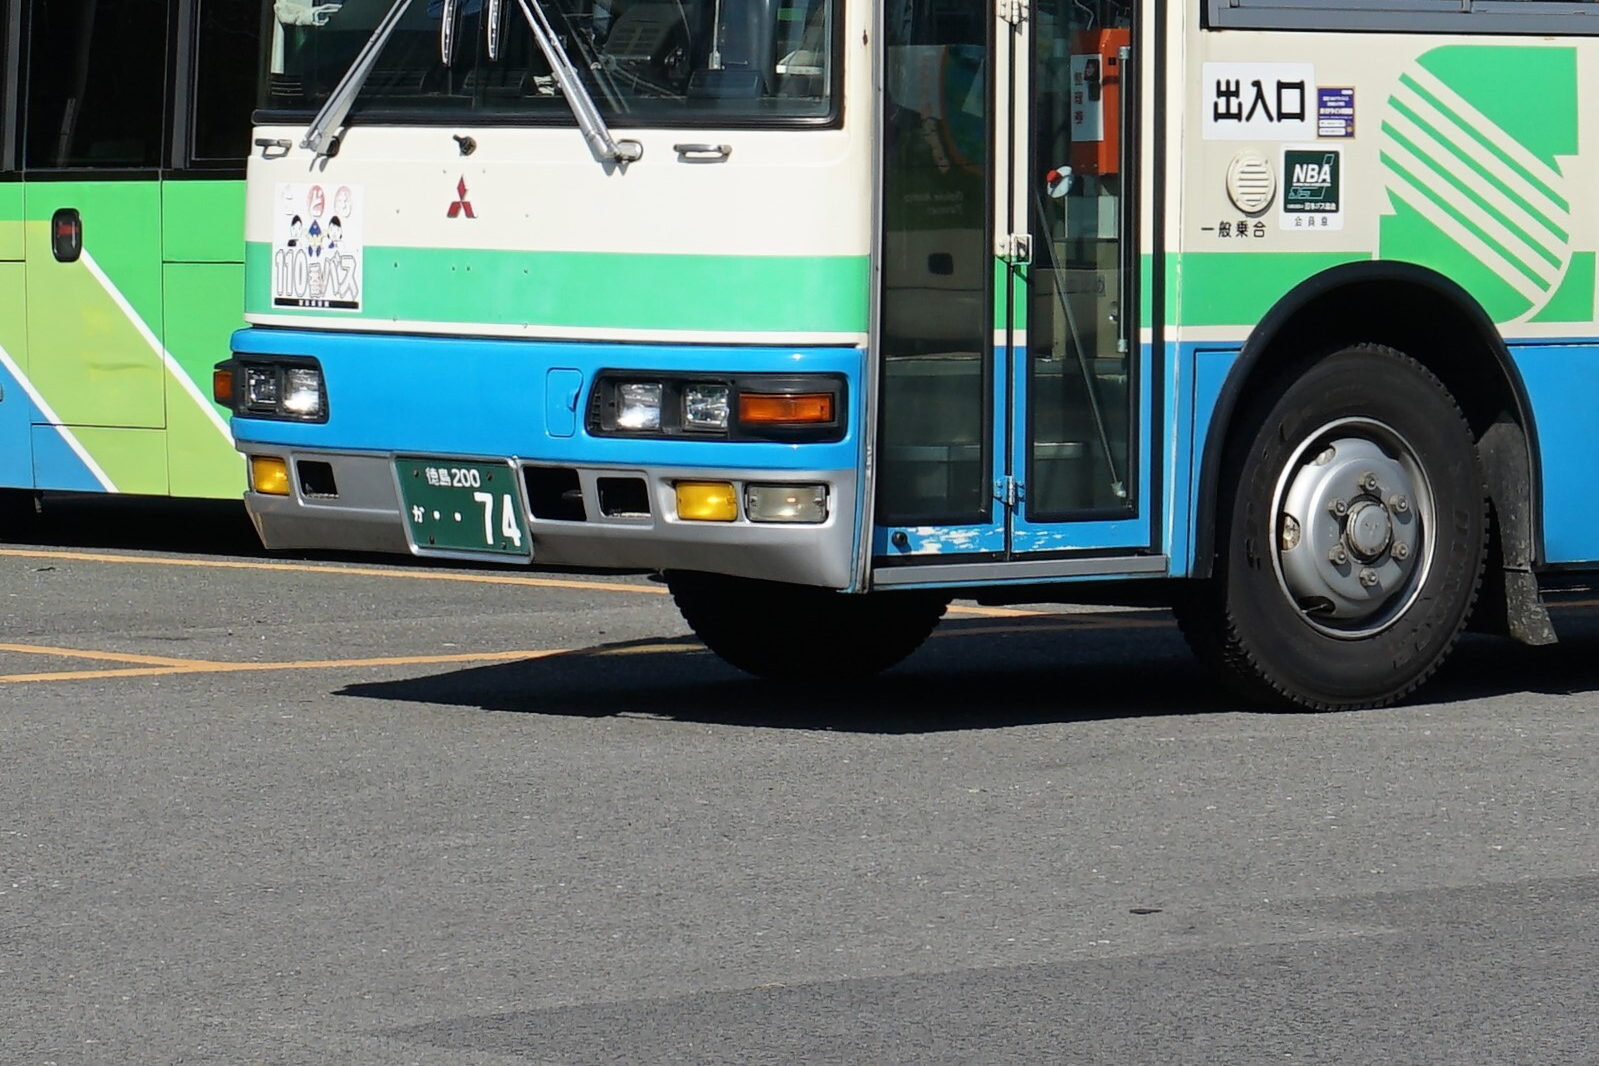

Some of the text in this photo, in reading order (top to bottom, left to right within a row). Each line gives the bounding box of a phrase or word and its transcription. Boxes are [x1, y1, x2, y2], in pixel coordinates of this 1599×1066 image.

[1213, 79, 1305, 123] 出入口
[1293, 164, 1332, 183] NBA
[1200, 220, 1267, 238] 一般乗合
